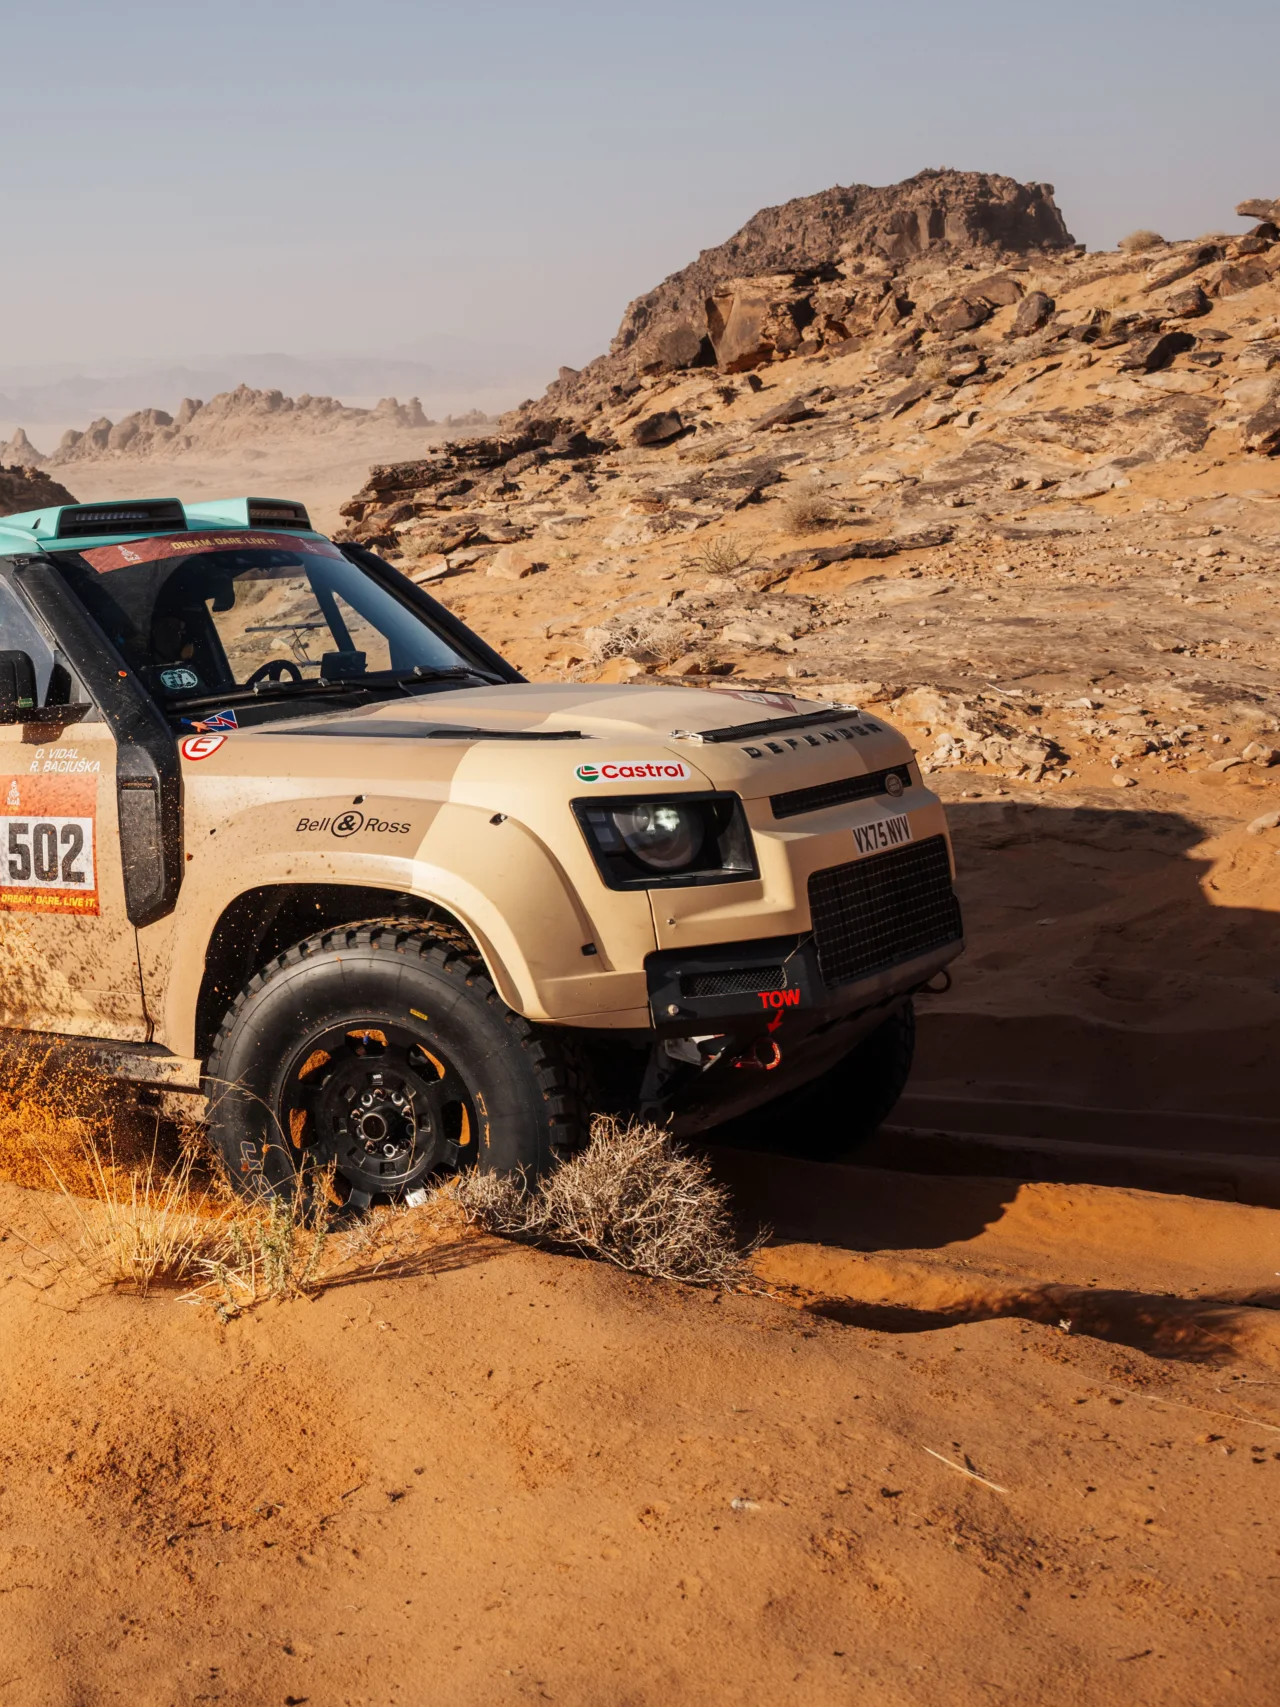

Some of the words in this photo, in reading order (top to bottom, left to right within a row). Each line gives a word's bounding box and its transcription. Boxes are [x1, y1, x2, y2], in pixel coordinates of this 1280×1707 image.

[170, 539, 215, 550] DREAM.
[214, 537, 246, 546] DARE.
[742, 722, 883, 759] DEFENDER
[35, 748, 45, 758] O.
[48, 748, 79, 758] VIDAL
[30, 761, 40, 772] R.
[43, 758, 100, 772] BACIUŠKA
[602, 764, 684, 778] Castrol
[296, 818, 330, 832] Bell
[364, 818, 412, 834] Ross
[852, 822, 888, 853] VX75
[888, 815, 910, 845] NVV
[8, 822, 85, 883] 502
[1, 894, 33, 904] DREAM
[36, 896, 62, 906] DARE.
[64, 898, 84, 906] LIVE
[758, 989, 800, 1008] TOW
